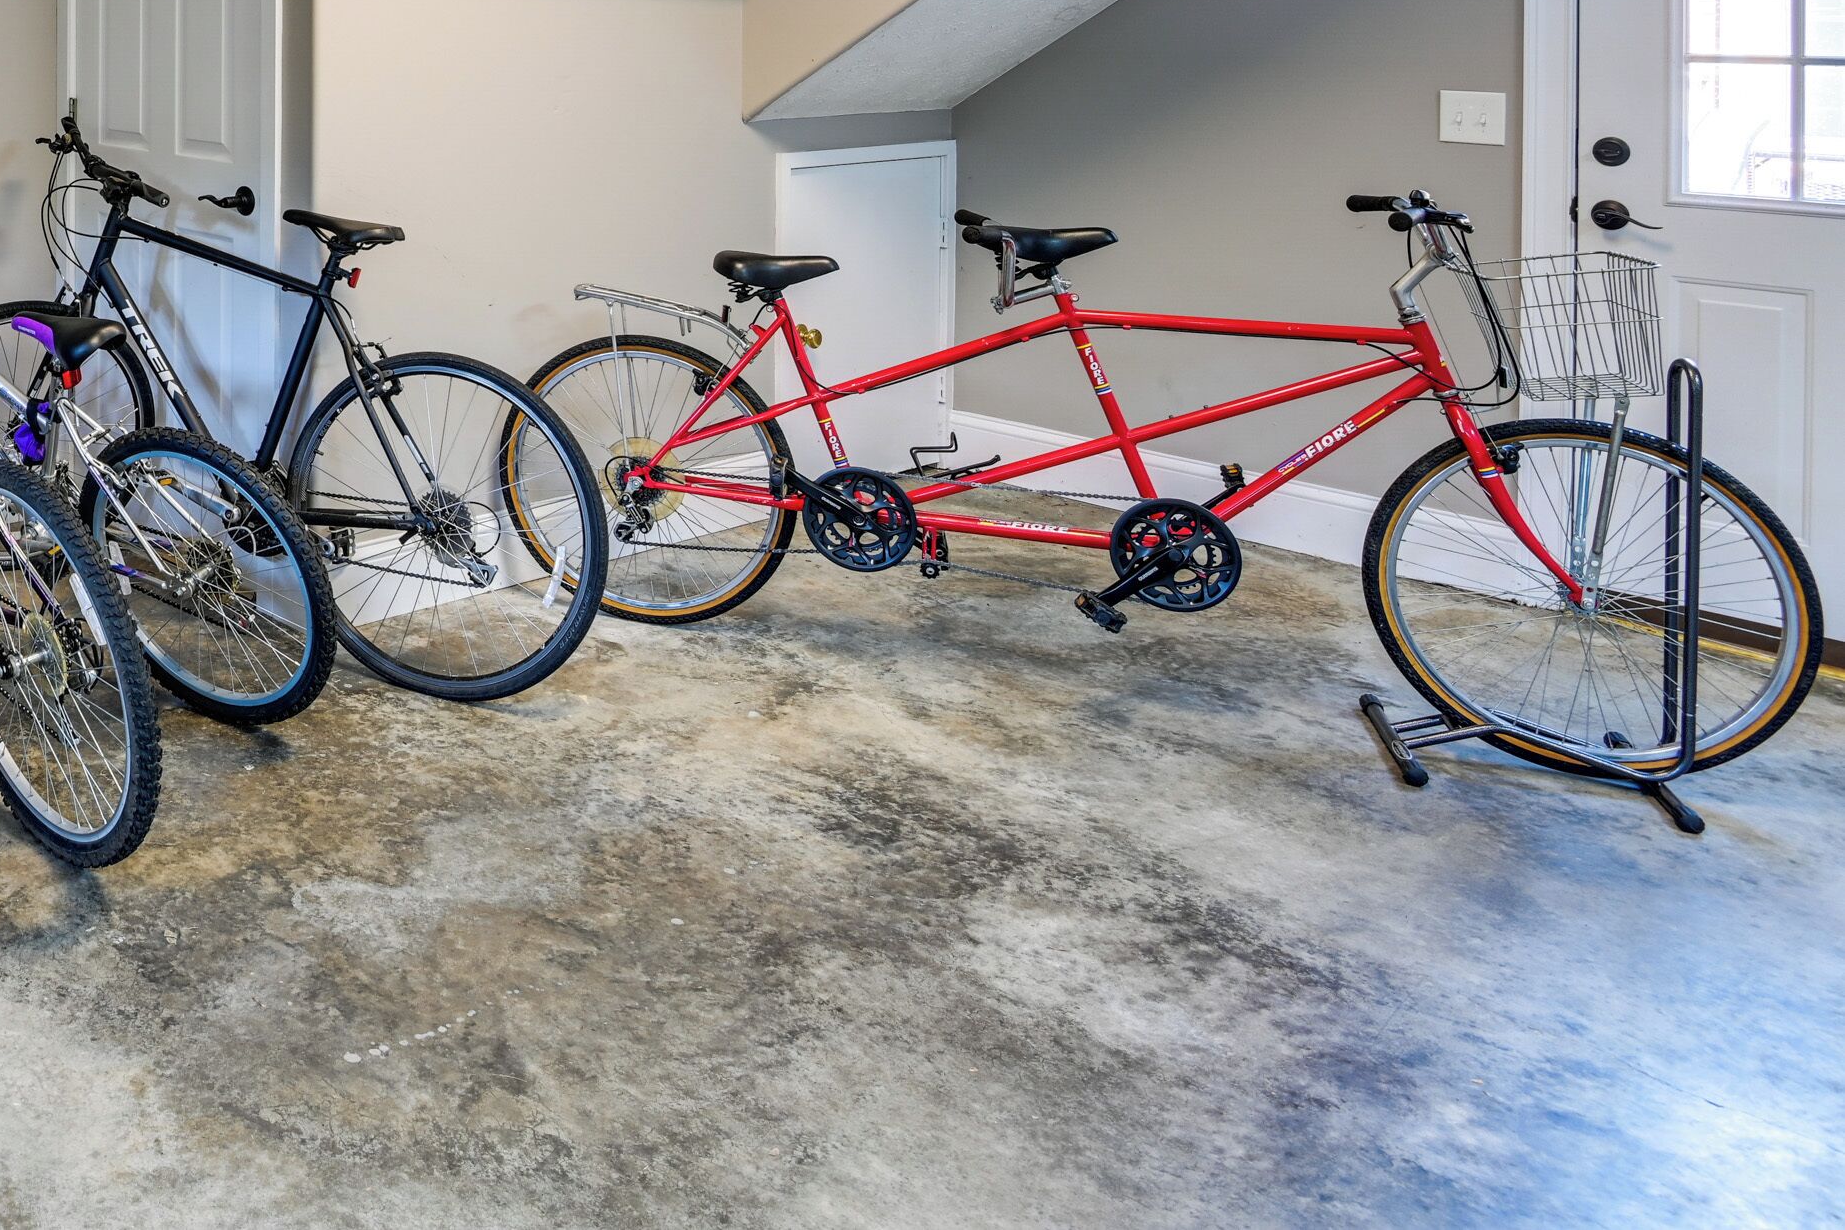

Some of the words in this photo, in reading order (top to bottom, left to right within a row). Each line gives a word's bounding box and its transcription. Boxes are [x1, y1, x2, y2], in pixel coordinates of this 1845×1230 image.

[122, 299, 184, 399] TREK
[1085, 347, 1105, 385] FIORE
[824, 422, 842, 457] FIORE
[1305, 420, 1357, 459] FIORE
[1011, 521, 1069, 533] FIORE
